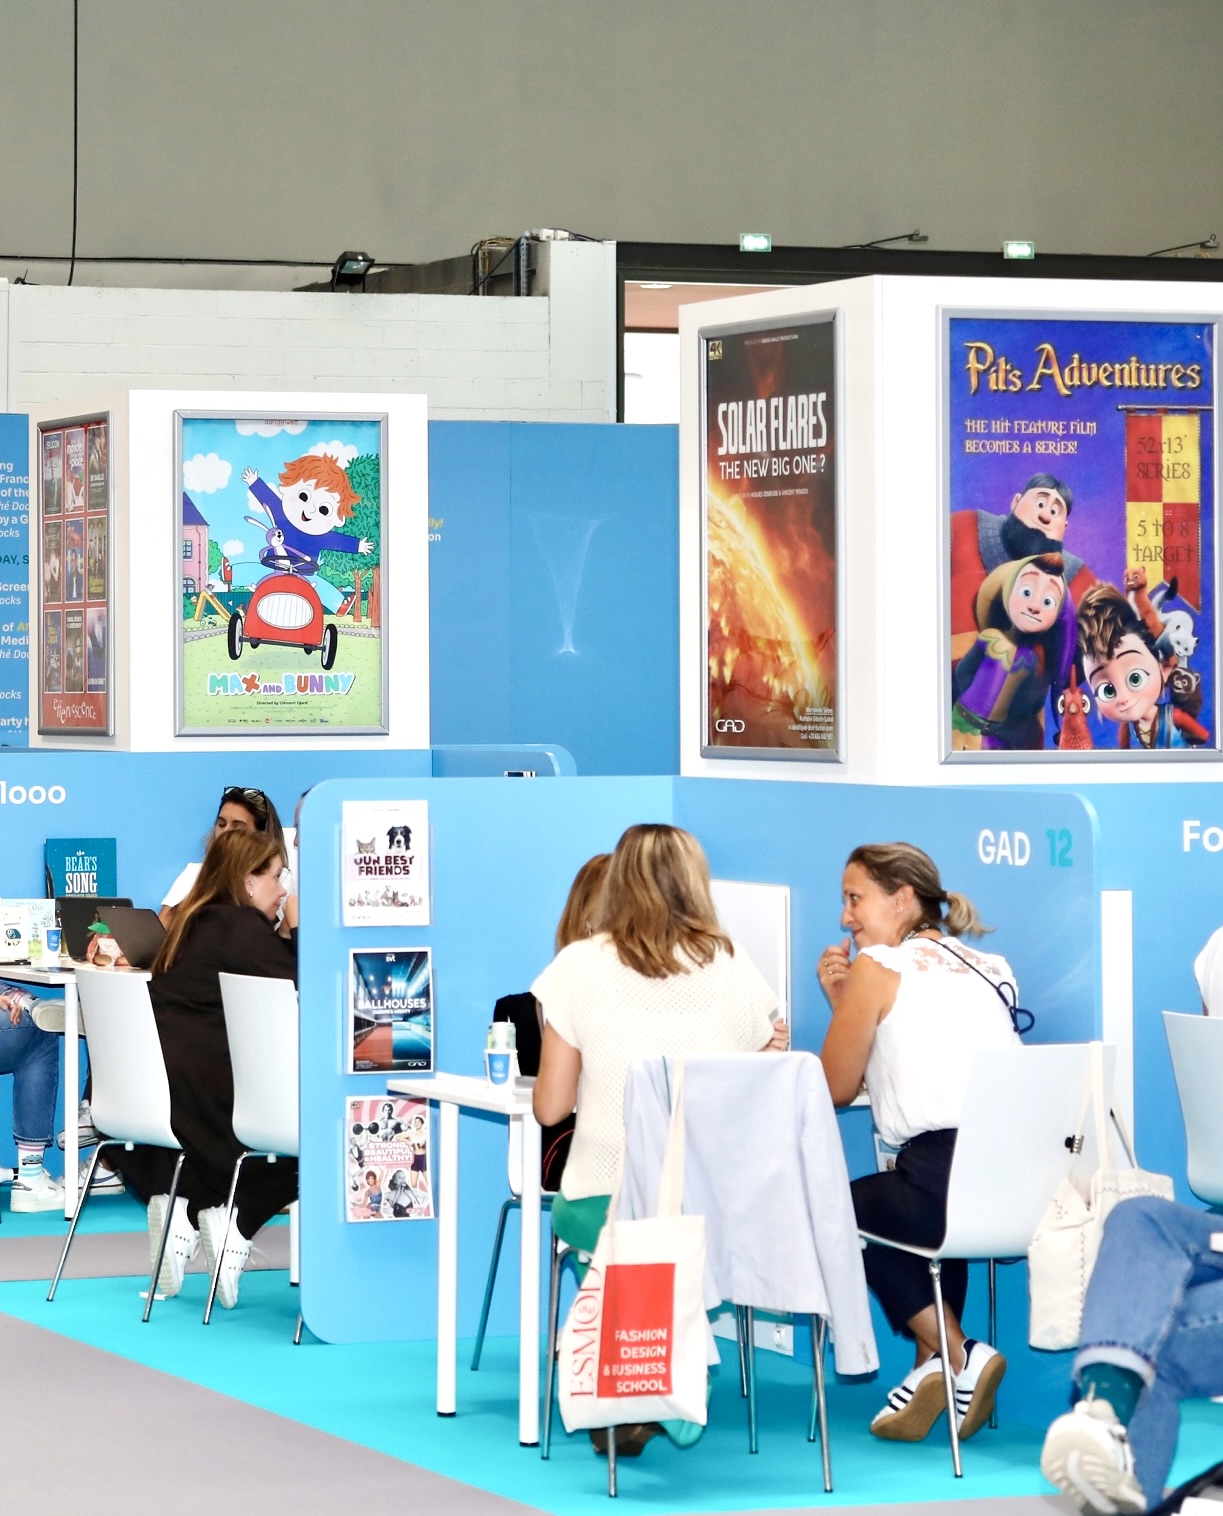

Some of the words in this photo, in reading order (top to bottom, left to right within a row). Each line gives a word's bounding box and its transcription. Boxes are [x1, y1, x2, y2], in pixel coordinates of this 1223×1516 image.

[1026, 343, 1202, 396] Adventures
[717, 399, 768, 456] SOLAR
[770, 392, 827, 451] FLARES
[965, 440, 1020, 455] BECOMES
[1023, 441, 1032, 453] A
[719, 461, 741, 480] THE
[743, 458, 770, 479] NEW
[772, 456, 790, 476] BIG
[792, 454, 817, 475] ONE
[0, 488, 12, 497] of
[11, 516, 18, 524] a
[1137, 519, 1147, 537] 5
[1179, 520, 1189, 537] 8
[2, 622, 14, 631] of
[209, 673, 260, 694] MAX
[262, 684, 282, 694] AND
[283, 673, 355, 694] BUNNY
[715, 719, 745, 733] GAD
[978, 828, 1031, 866] GAD
[1046, 828, 1073, 867] 12
[65, 856, 97, 871] BEAR'S
[384, 855, 415, 865] BEST
[358, 866, 410, 876] FRIENDS
[65, 872, 97, 893] SONG
[358, 998, 427, 1010] BALLHOUSES
[615, 1328, 667, 1342] FASHION
[620, 1346, 666, 1359] DESIGN
[603, 1364, 611, 1376] &
[616, 1380, 667, 1393] SCHOOL
